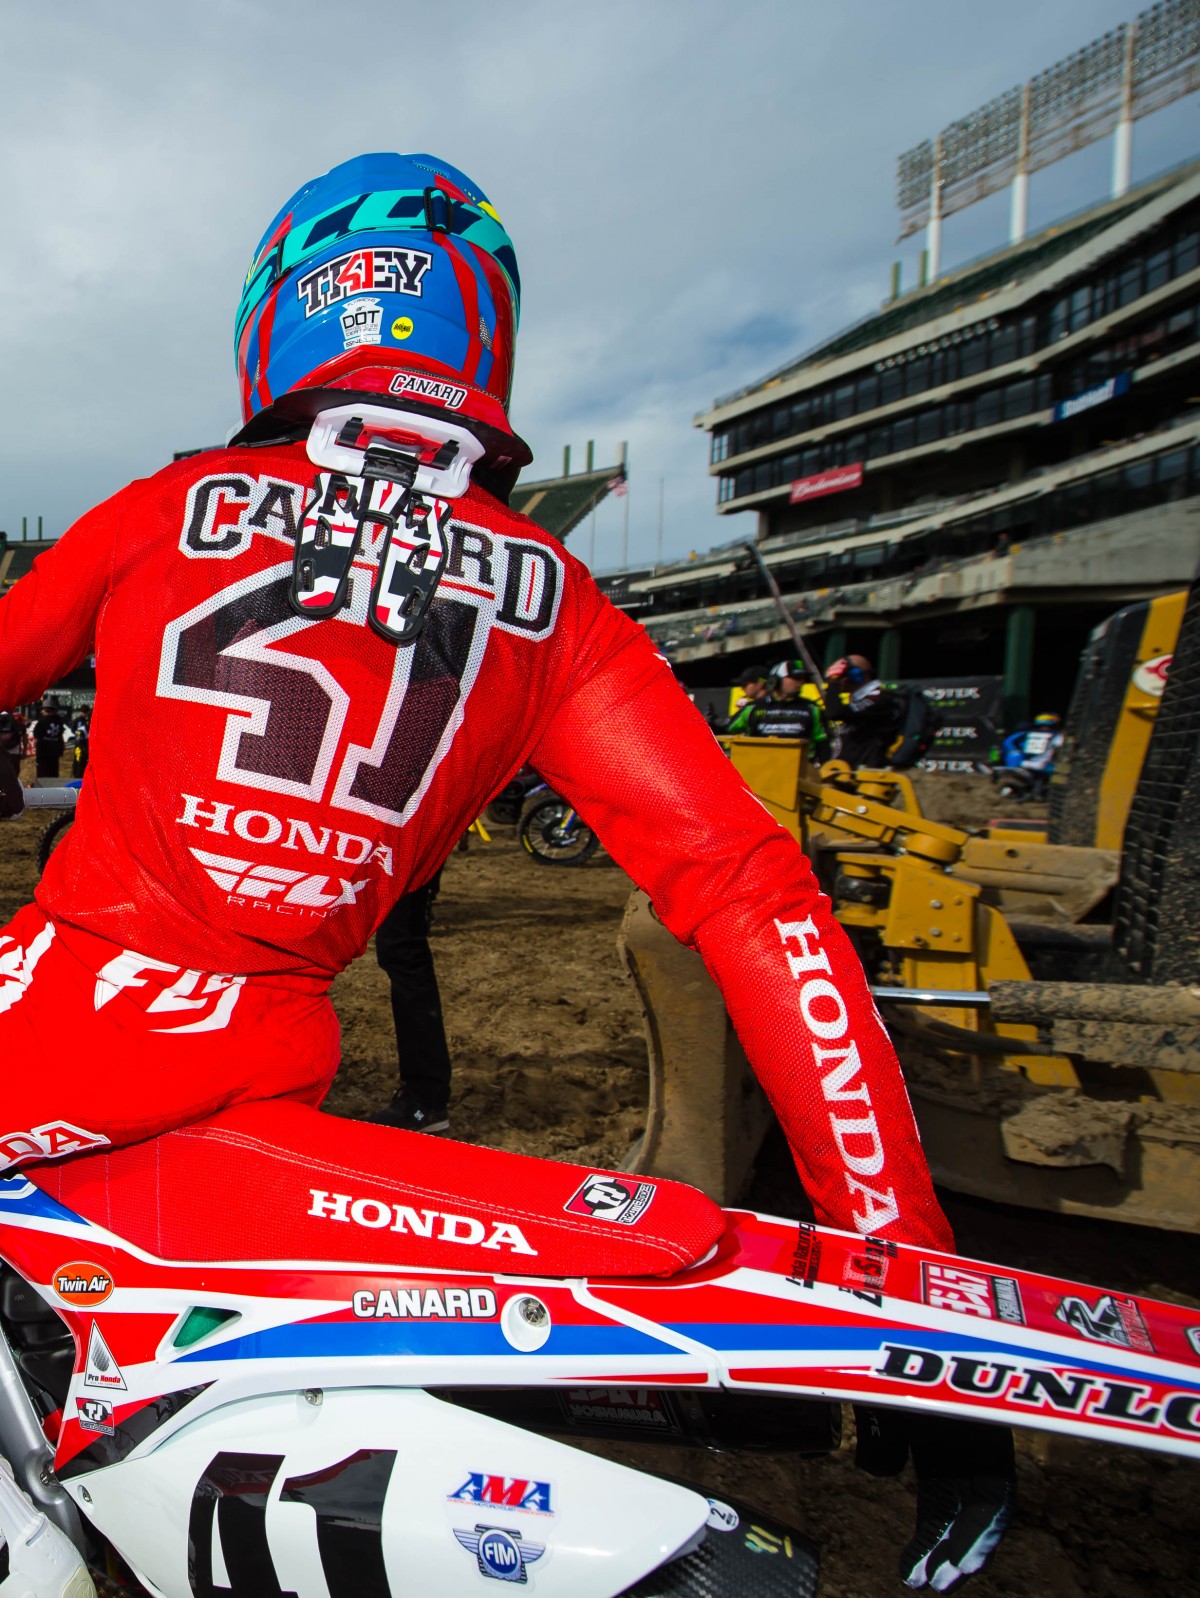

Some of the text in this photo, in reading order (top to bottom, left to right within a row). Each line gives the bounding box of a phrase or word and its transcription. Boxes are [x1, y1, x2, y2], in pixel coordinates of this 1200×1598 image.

[342, 310, 380, 329] DOT
[390, 373, 467, 409] CANARD
[792, 471, 862, 497] Budweiser
[176, 793, 394, 877] HONDA
[226, 894, 341, 919] RACING
[774, 913, 901, 1235] HONDA
[307, 1188, 539, 1256] HONDA
[58, 1275, 110, 1293] Twin Air
[352, 1288, 498, 1319] CANARD
[87, 1373, 122, 1384] Pro Honda
[446, 1471, 555, 1514] AMA
[187, 1448, 398, 1598] 41
[484, 1541, 517, 1567] FIM
